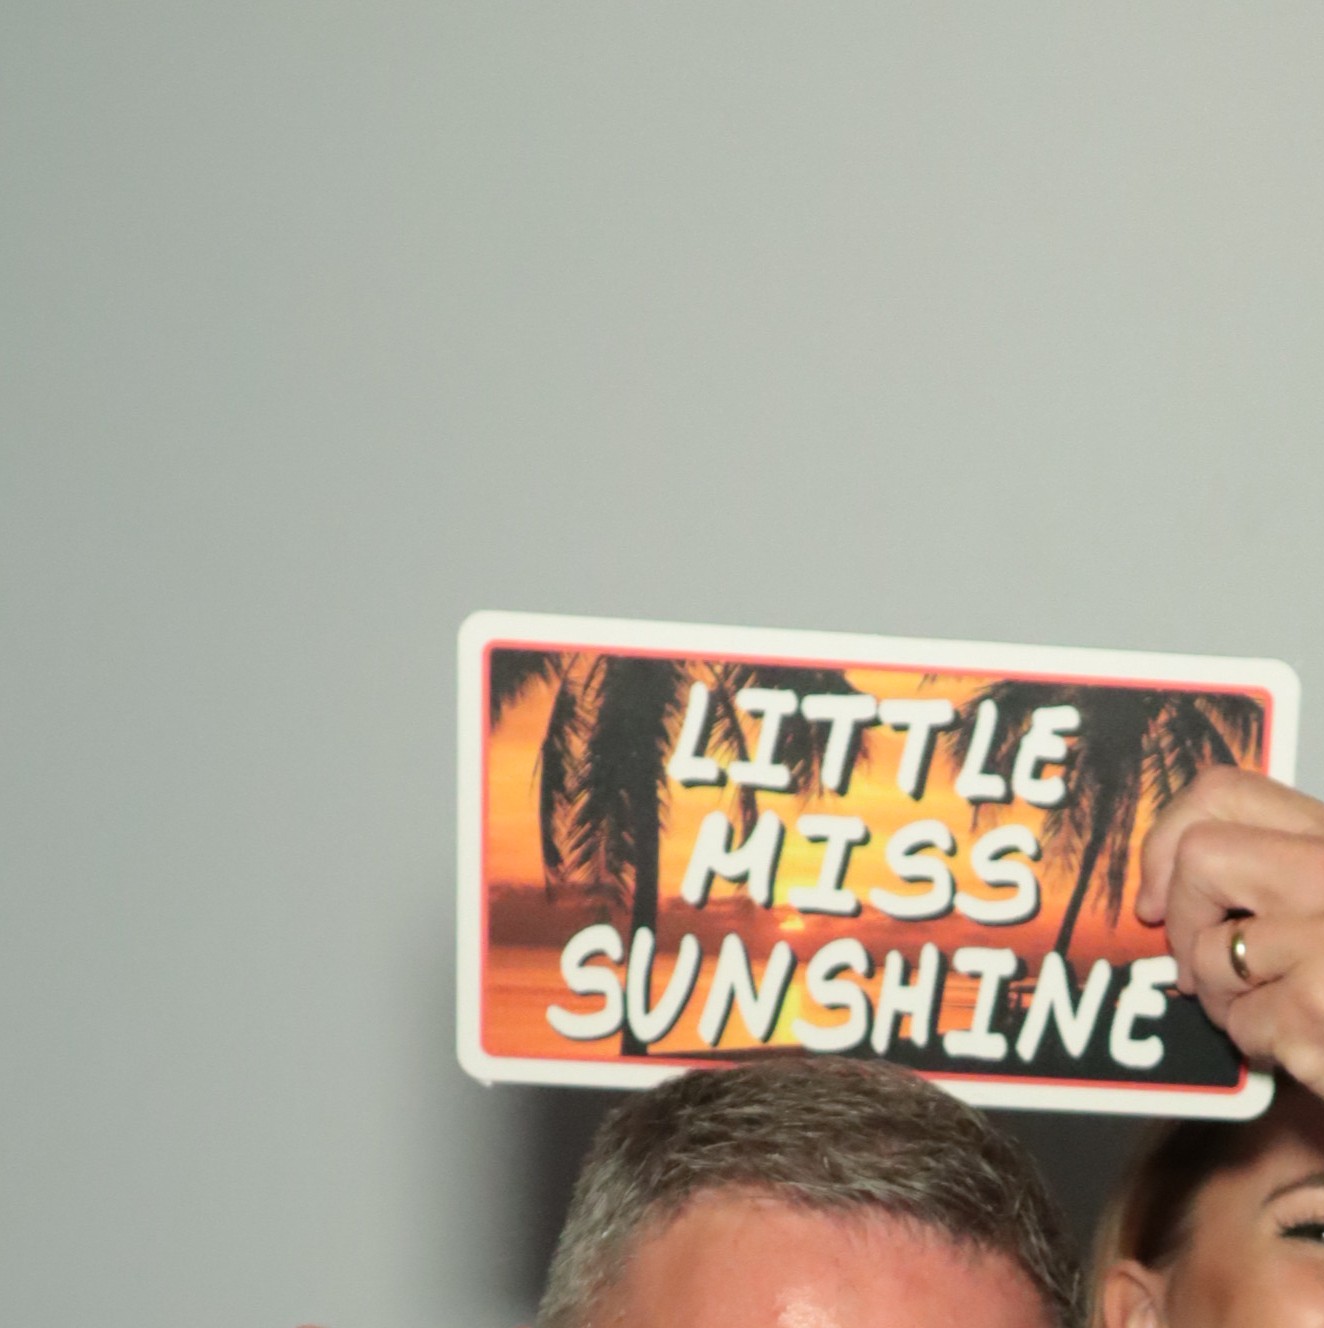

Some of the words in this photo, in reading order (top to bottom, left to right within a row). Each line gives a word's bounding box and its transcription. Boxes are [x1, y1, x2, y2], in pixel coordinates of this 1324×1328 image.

[667, 681, 1080, 805] LITTLE
[680, 809, 1041, 923] MISS
[547, 924, 1178, 1068] SUNSHINE
